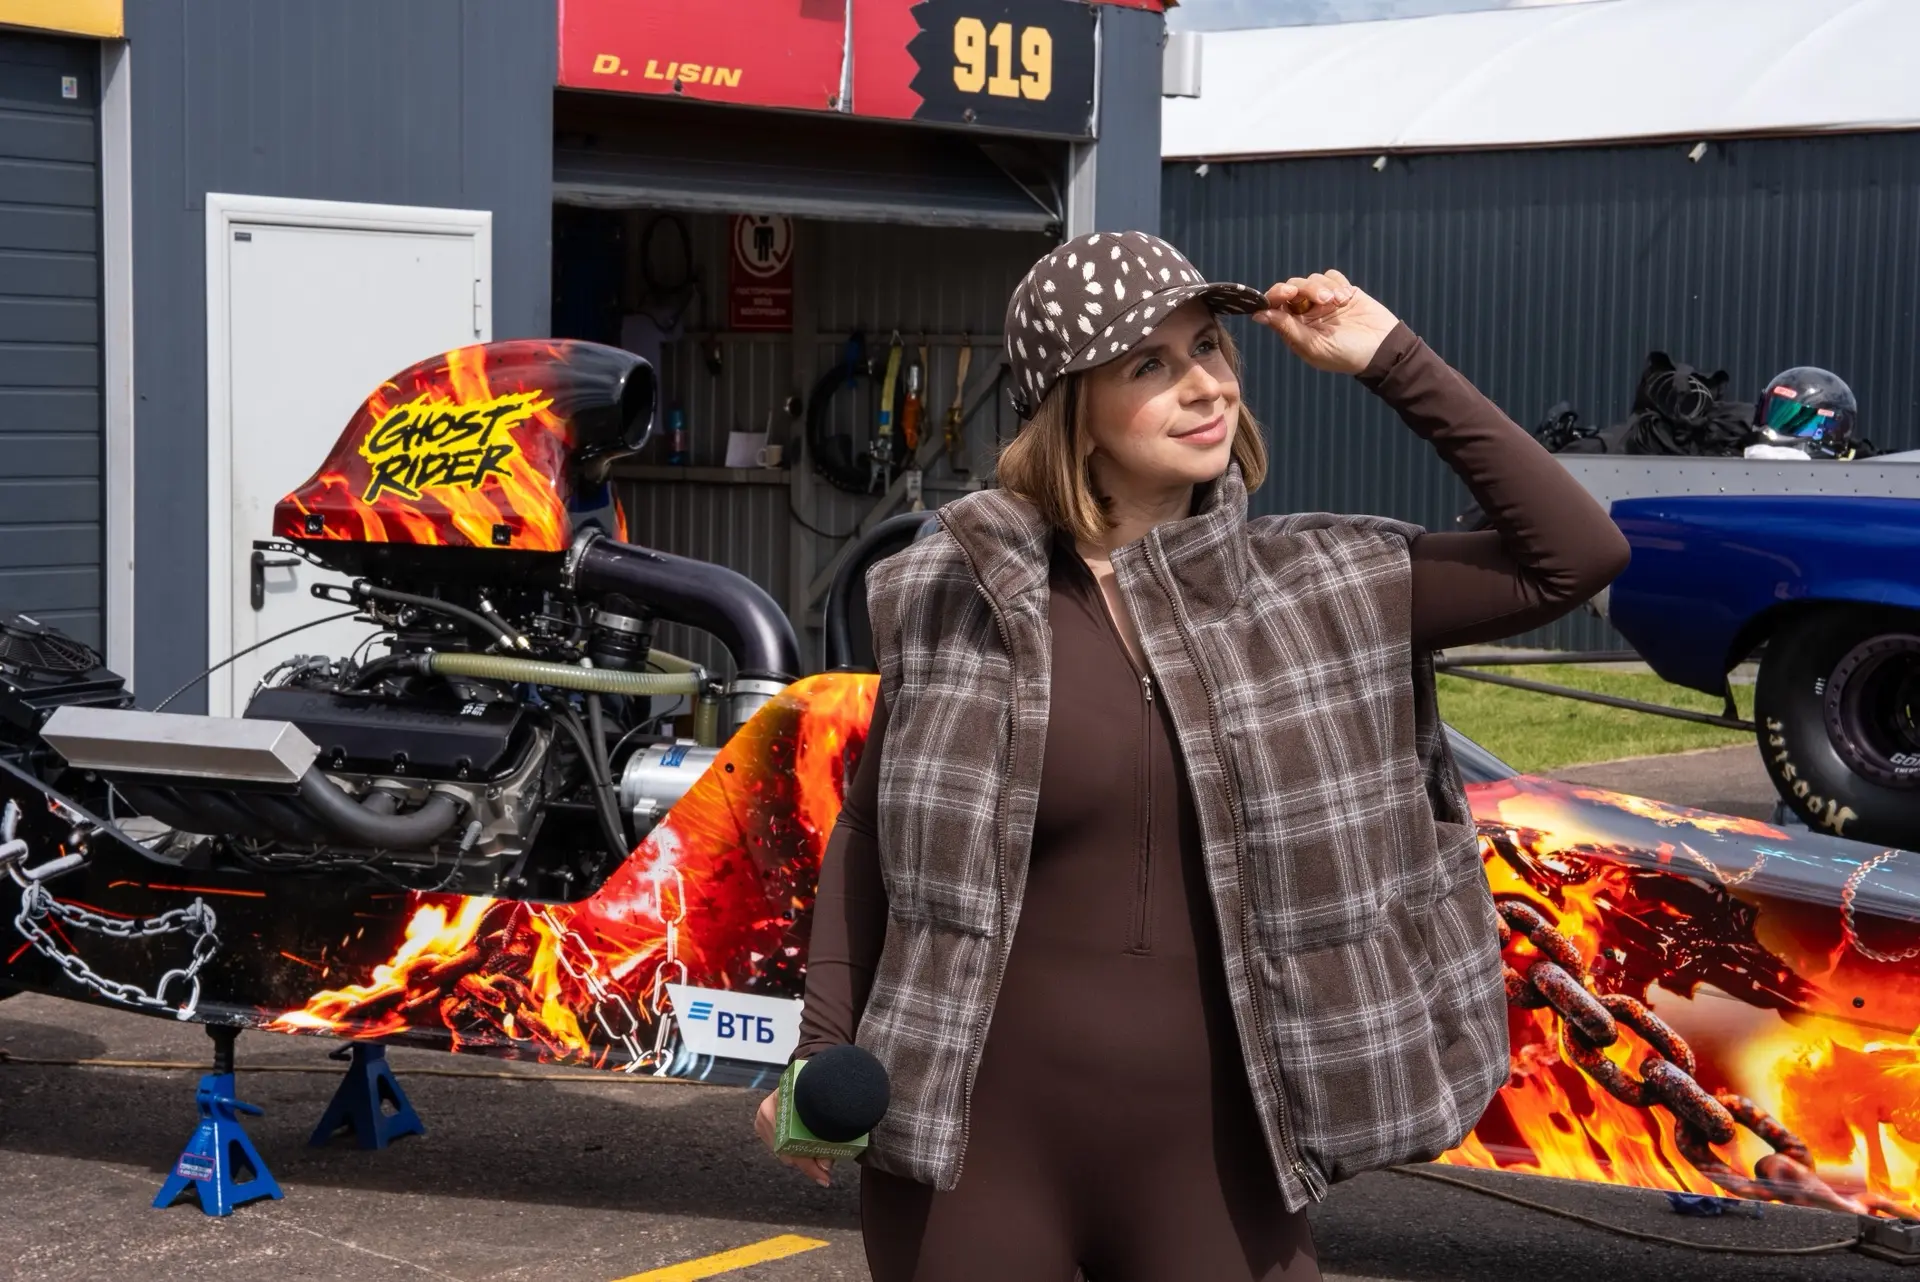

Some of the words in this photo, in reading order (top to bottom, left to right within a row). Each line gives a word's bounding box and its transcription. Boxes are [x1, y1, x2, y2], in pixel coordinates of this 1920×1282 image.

[593, 53, 629, 77] D.
[644, 59, 743, 88] LISIN
[953, 16, 1053, 101] 919
[368, 402, 525, 454] GHOST
[363, 444, 514, 502] RIDER
[717, 1010, 775, 1044] ВТБ
